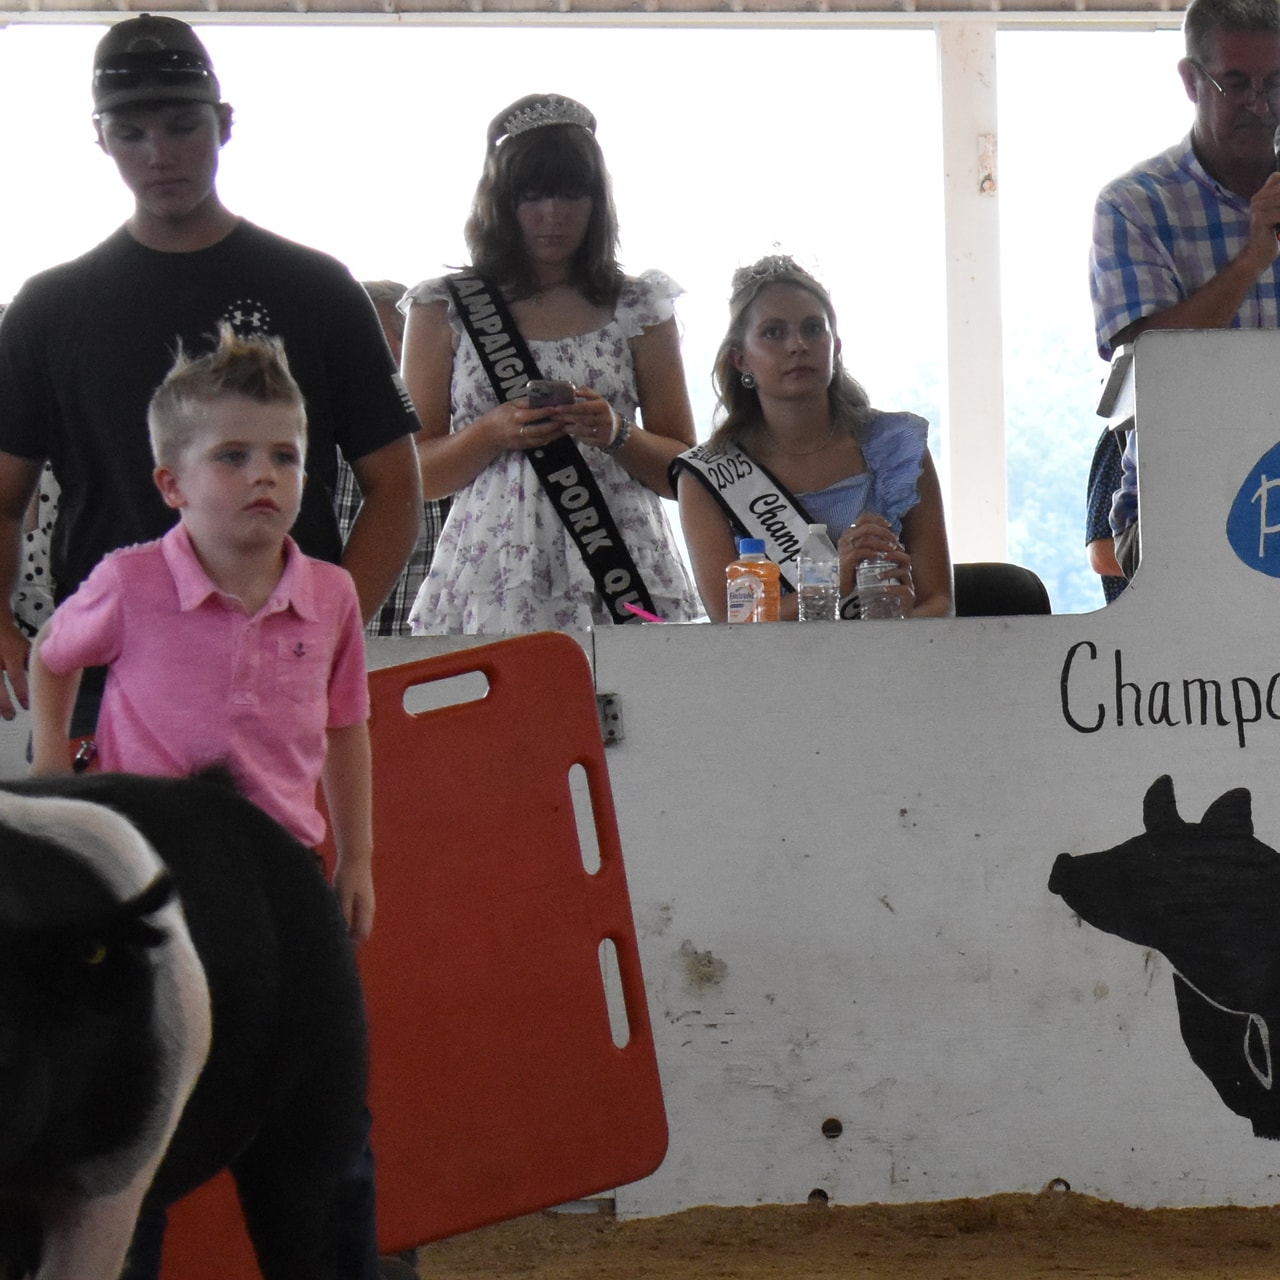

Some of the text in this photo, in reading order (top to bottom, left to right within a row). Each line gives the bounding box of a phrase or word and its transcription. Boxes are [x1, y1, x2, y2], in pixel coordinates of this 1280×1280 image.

[453, 277, 646, 625] AMPAIGN PORK QU
[708, 453, 753, 491] 2025
[749, 493, 802, 565] Champ
